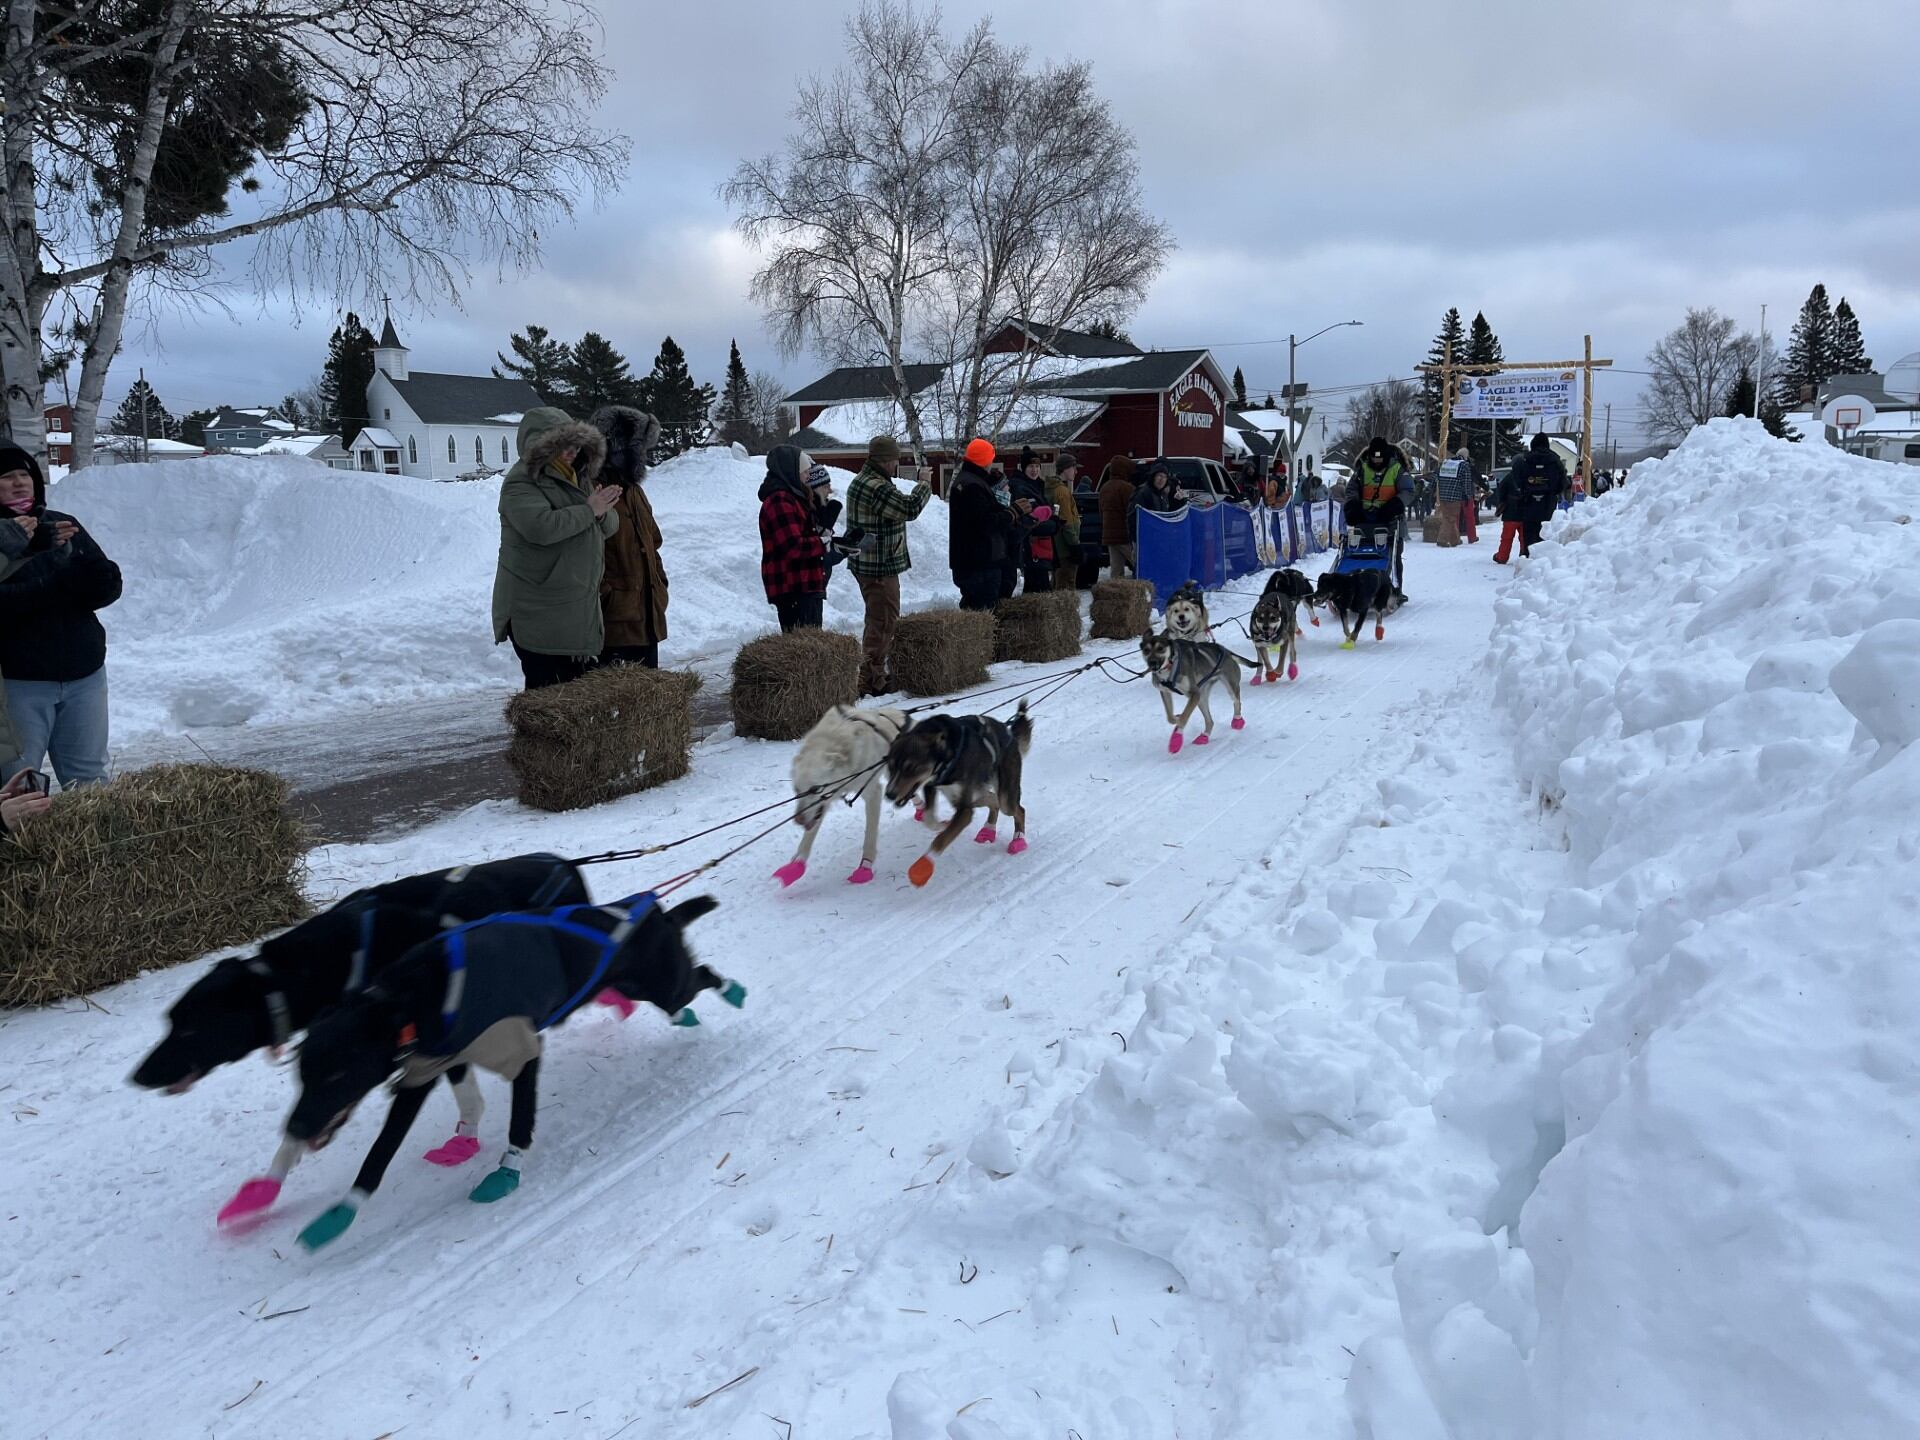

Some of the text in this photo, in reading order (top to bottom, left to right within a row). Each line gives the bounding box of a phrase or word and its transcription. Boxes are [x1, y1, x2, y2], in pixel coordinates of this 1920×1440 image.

[1490, 376, 1557, 386] CHECKPOINT:
[1169, 373, 1221, 416] EAGLE HARBOR
[1480, 384, 1568, 395] EAGLE HARBOR
[1178, 411, 1213, 428] TOWNSHIP
